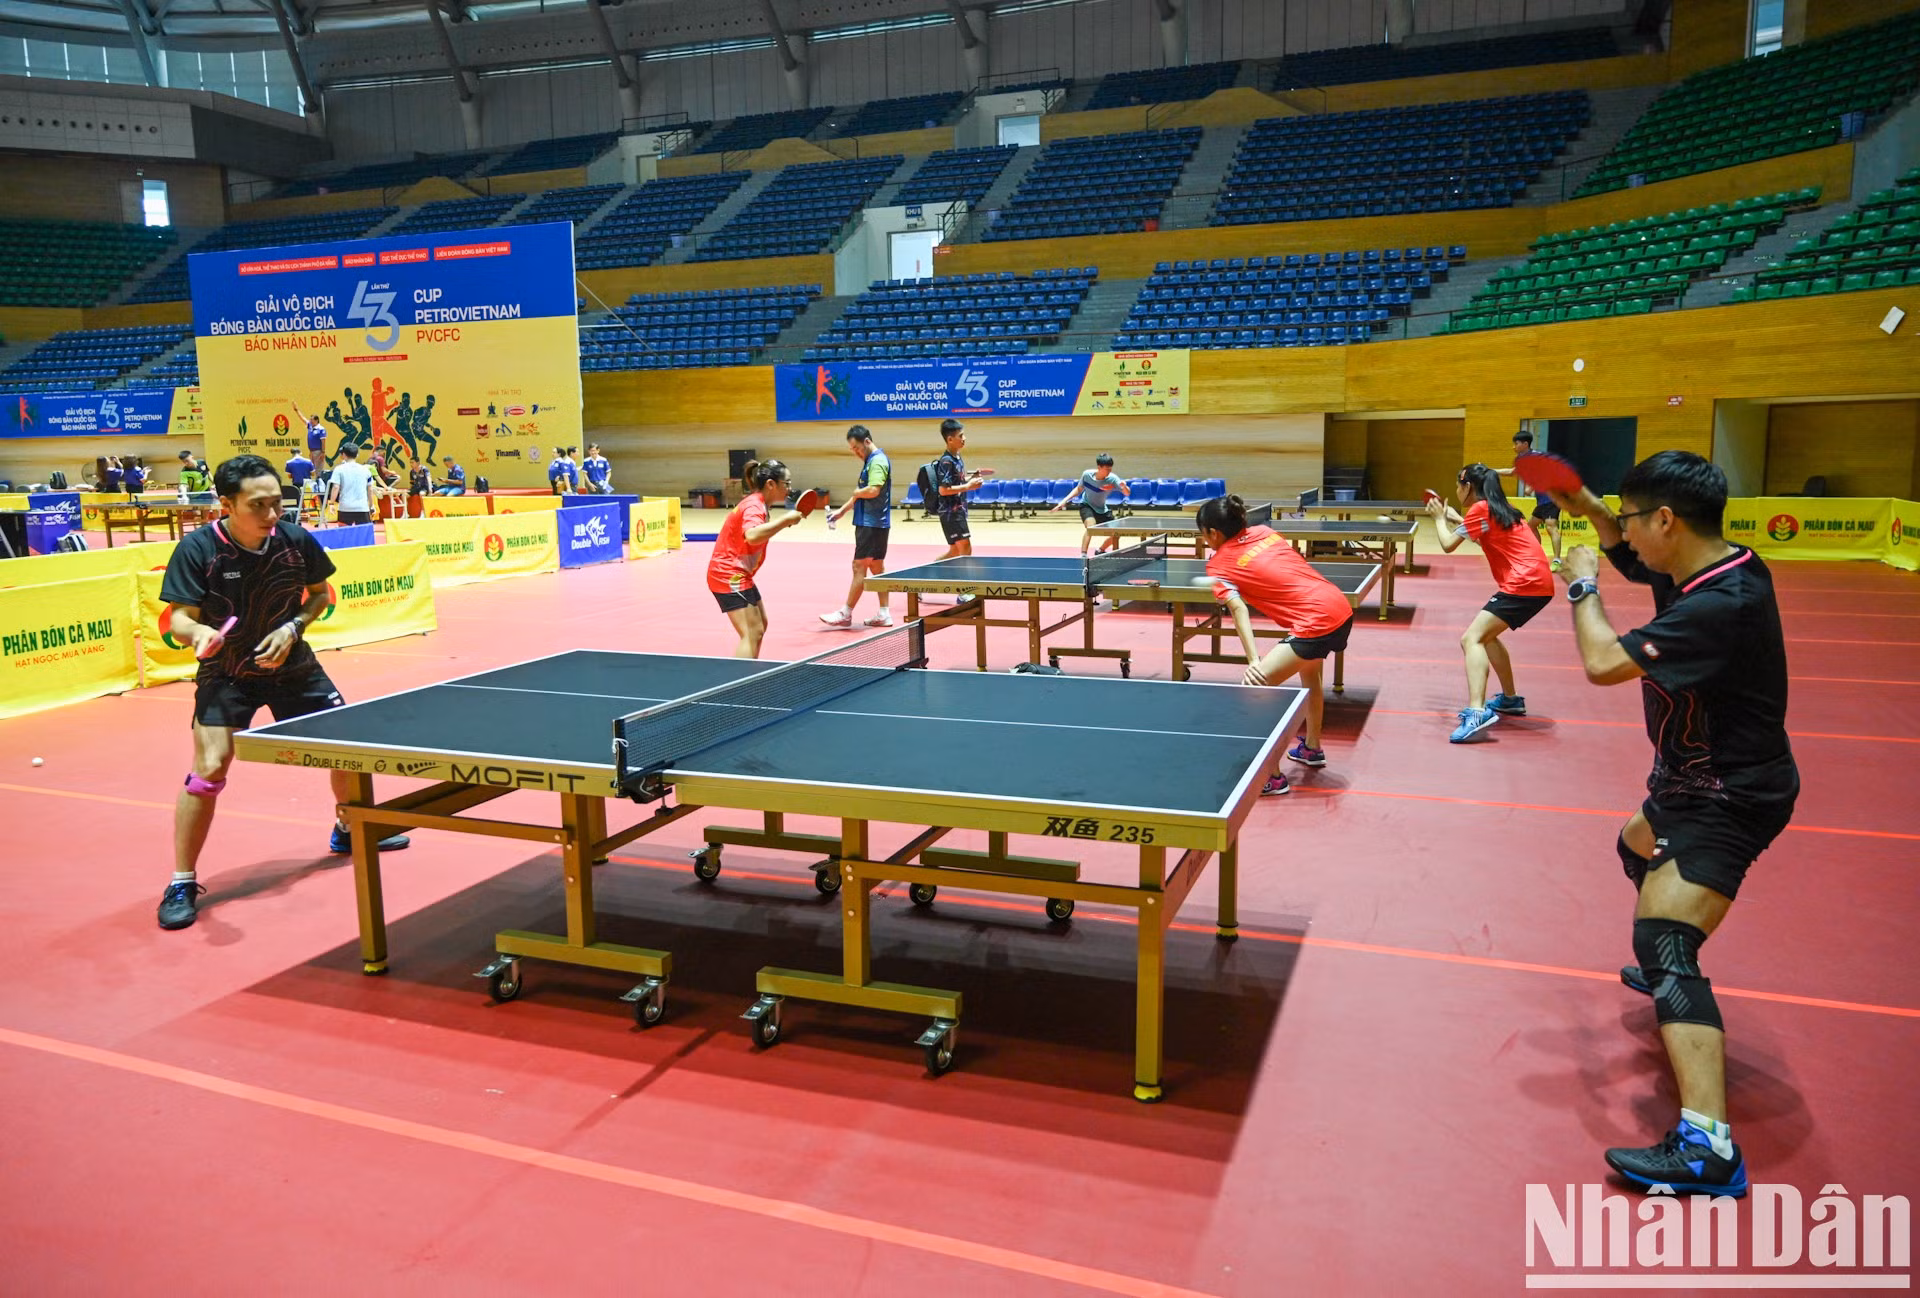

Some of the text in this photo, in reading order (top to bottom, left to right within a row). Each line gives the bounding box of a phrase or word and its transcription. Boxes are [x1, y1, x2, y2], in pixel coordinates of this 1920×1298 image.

[414, 288, 442, 303] CUP
[256, 294, 334, 313] GIẢI VÔ ĐỊCH
[415, 304, 520, 323] PETROVIETNAM
[211, 311, 336, 334] BÓNG BÀN QUỐC GIA
[245, 332, 336, 351] BÁO NHÂN DÂN
[417, 328, 460, 343] PVCFC
[896, 380, 947, 391] GIẢI VÔ ĐỊCH
[998, 380, 1016, 388] CUP
[864, 390, 948, 401] BÓNG BÀN QUỐC GIA
[998, 389, 1064, 398] PETROVIETNAM
[887, 400, 948, 411] BÁO NHÂN DÂN
[998, 400, 1027, 408] PVCFC
[496, 449, 520, 457] Vinamilk
[1562, 519, 1587, 530] CÀ MAU
[1730, 519, 1750, 530] PHÂN
[1804, 518, 1875, 531] PHÂN BÓN CÀ MAU
[454, 540, 460, 553] CÀ
[462, 542, 474, 552] MAU
[506, 538, 520, 548] PHÂN
[532, 534, 538, 544] CÀ
[538, 534, 548, 544] MAU
[571, 538, 592, 550] Double
[341, 575, 414, 600] PHÂN BÓN CÀ MAU
[986, 587, 1058, 596] MOFIT
[2, 619, 113, 656] PHÂN BÓN CÀ MAU
[303, 754, 340, 769] DOUBLE
[343, 761, 363, 771] FISH
[451, 764, 585, 792] MOFIT
[1041, 816, 1155, 844] 双鱼 235
